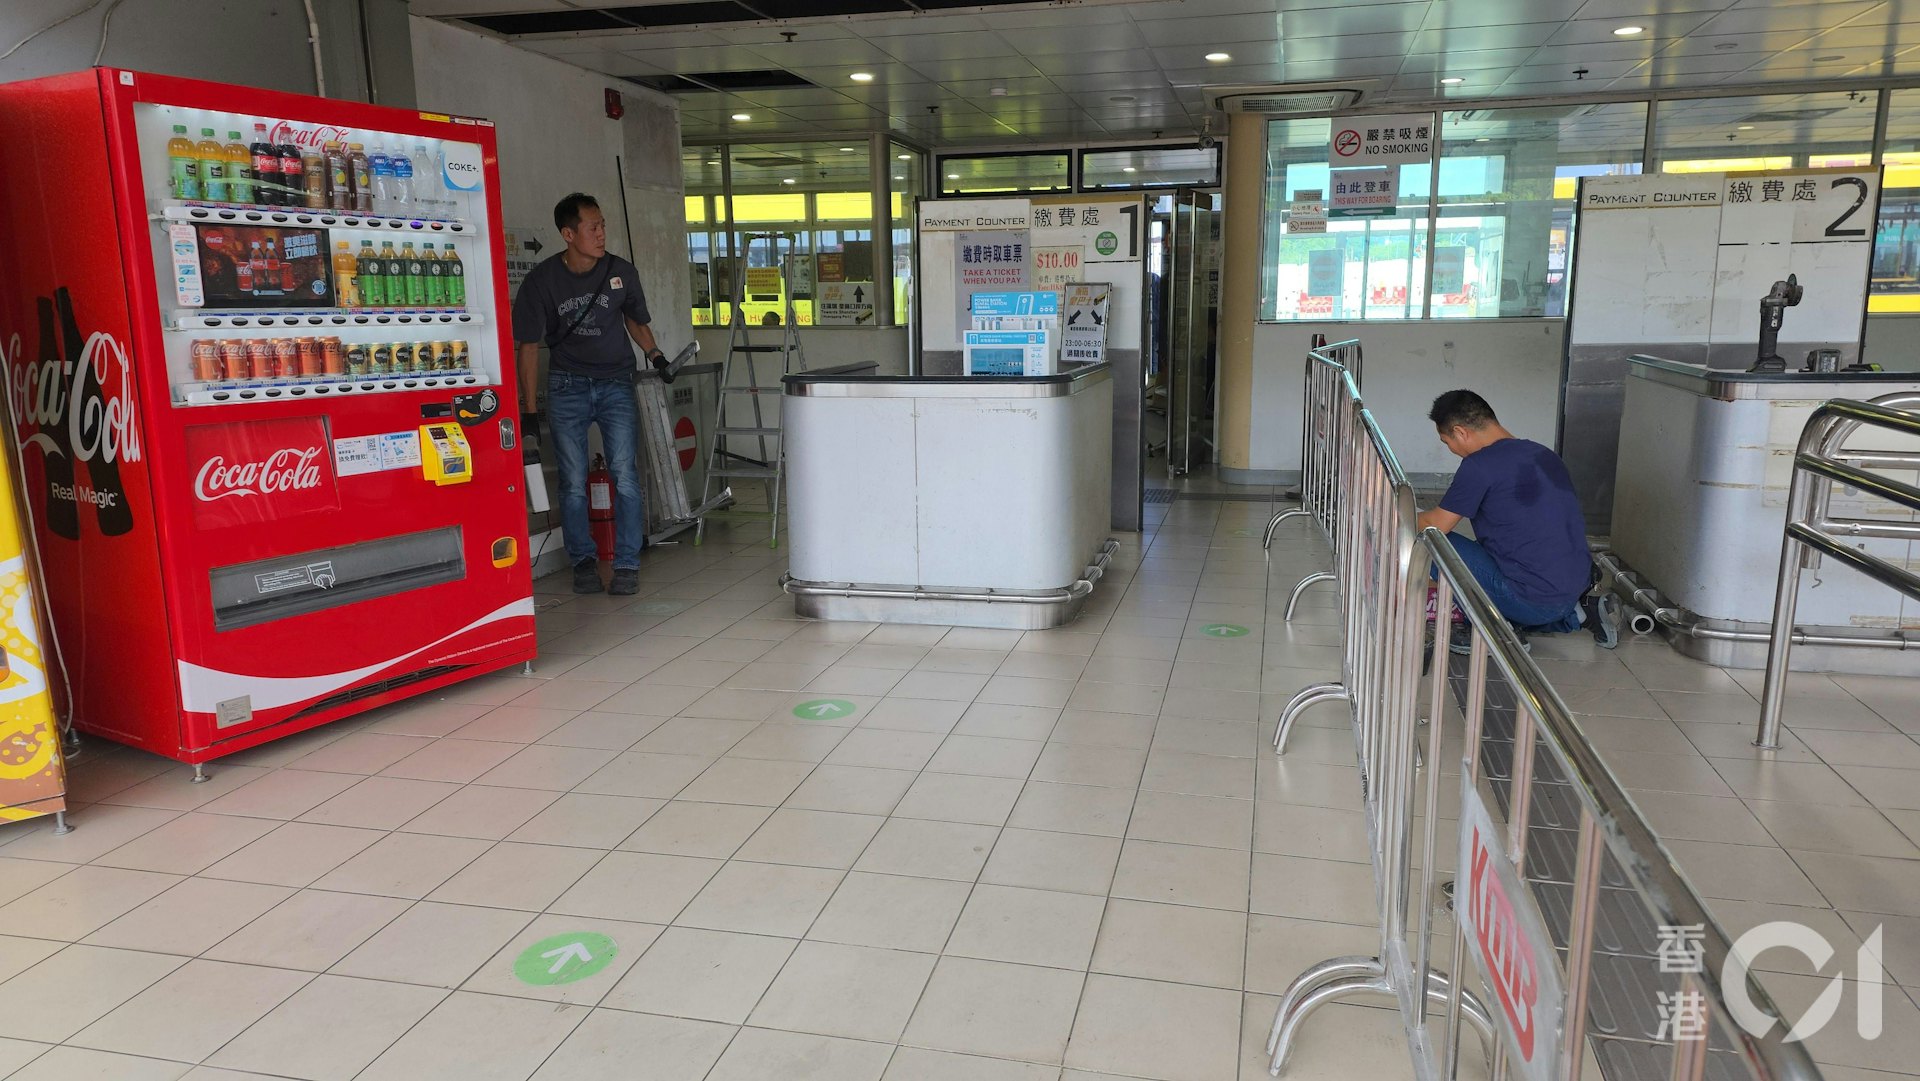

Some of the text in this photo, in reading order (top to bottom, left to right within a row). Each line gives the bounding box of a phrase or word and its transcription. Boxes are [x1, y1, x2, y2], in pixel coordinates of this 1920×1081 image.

[1366, 126, 1429, 141] 嚴禁吸煙
[1365, 143, 1429, 155] NO SMOKING
[1336, 180, 1391, 194] 由此登車
[1728, 179, 1817, 203] 繳費處
[1824, 176, 1869, 237] 2
[924, 217, 1025, 227] PAYMENT COUNTER
[1034, 207, 1099, 228] 繳費處
[1119, 204, 1138, 257] 1
[963, 244, 1023, 263] 繳費時取車票
[1036, 252, 1078, 269] $10.00
[993, 268, 1021, 276] TICKET
[1065, 339, 1102, 347] 23:00-06:30
[194, 446, 323, 502] Coca-Cola
[51, 482, 77, 500] Real
[1468, 824, 1538, 1063] KMB
